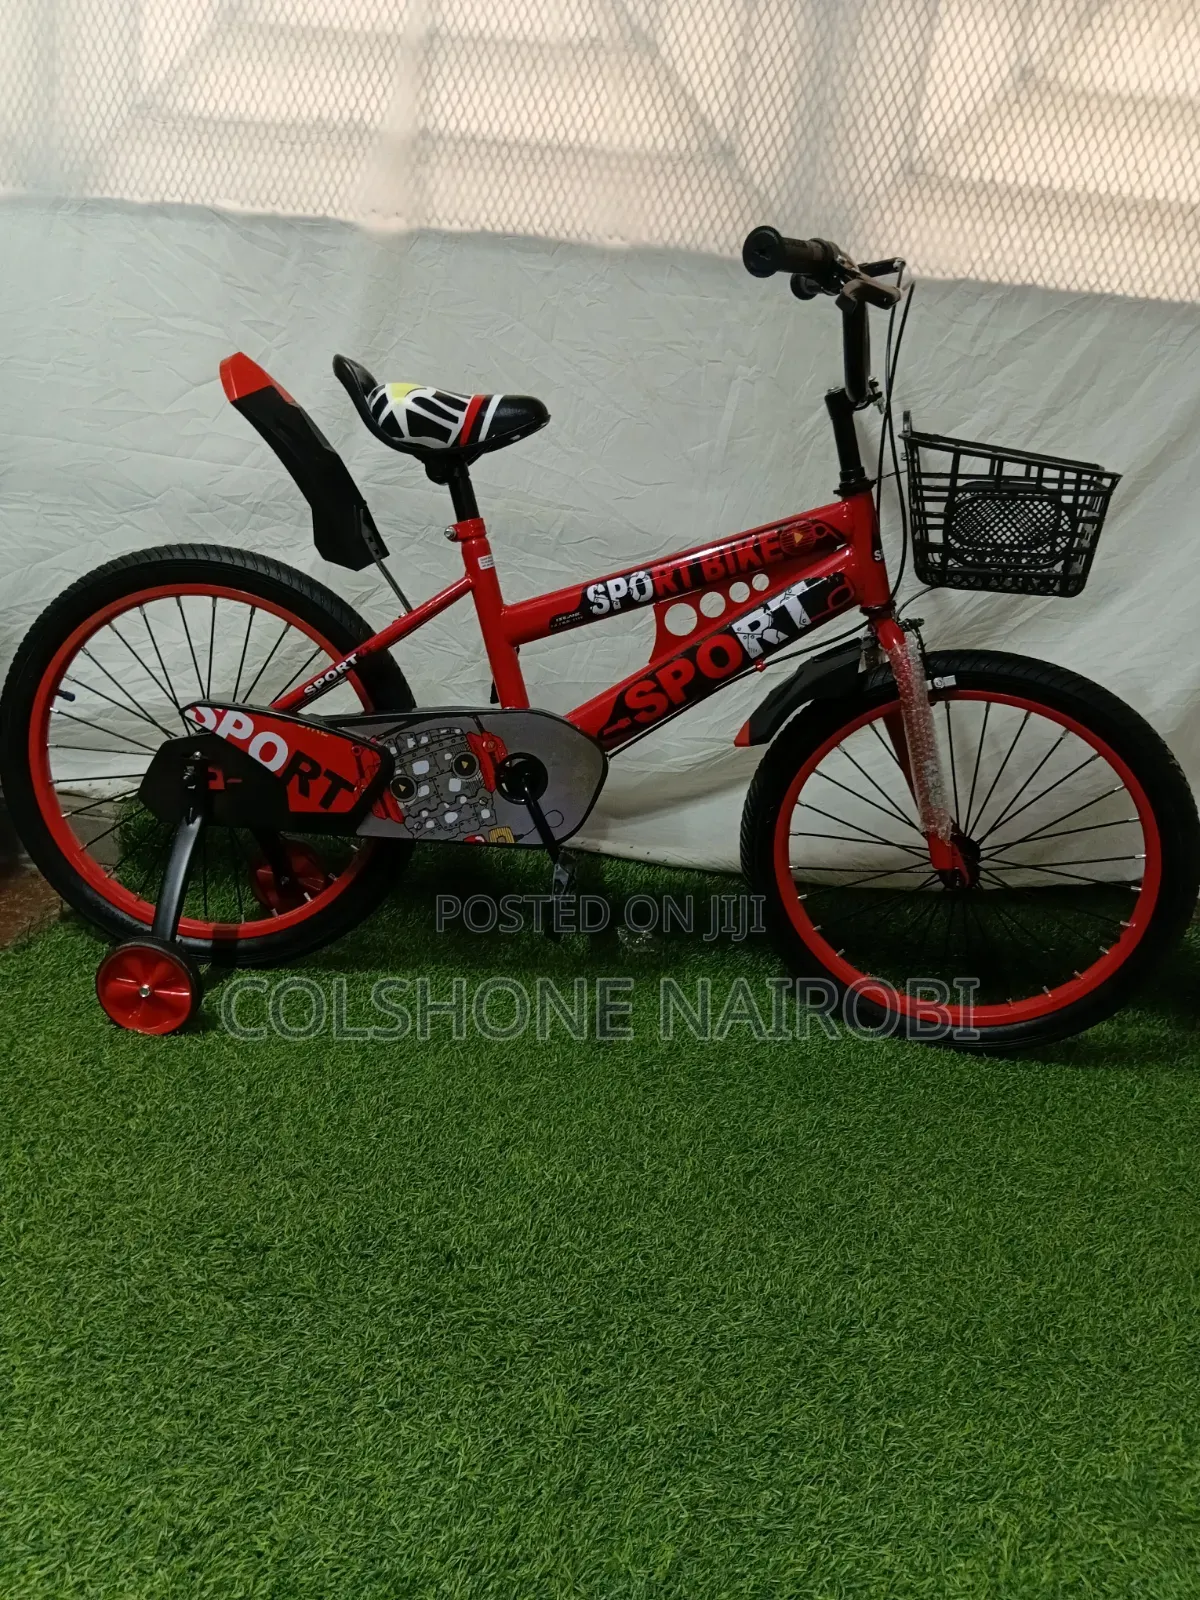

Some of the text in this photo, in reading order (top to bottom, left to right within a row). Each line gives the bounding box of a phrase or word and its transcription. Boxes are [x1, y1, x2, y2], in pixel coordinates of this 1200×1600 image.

[586, 530, 784, 615] SPORT BIKE
[304, 653, 359, 696] SPORT
[623, 580, 813, 724] SPORT
